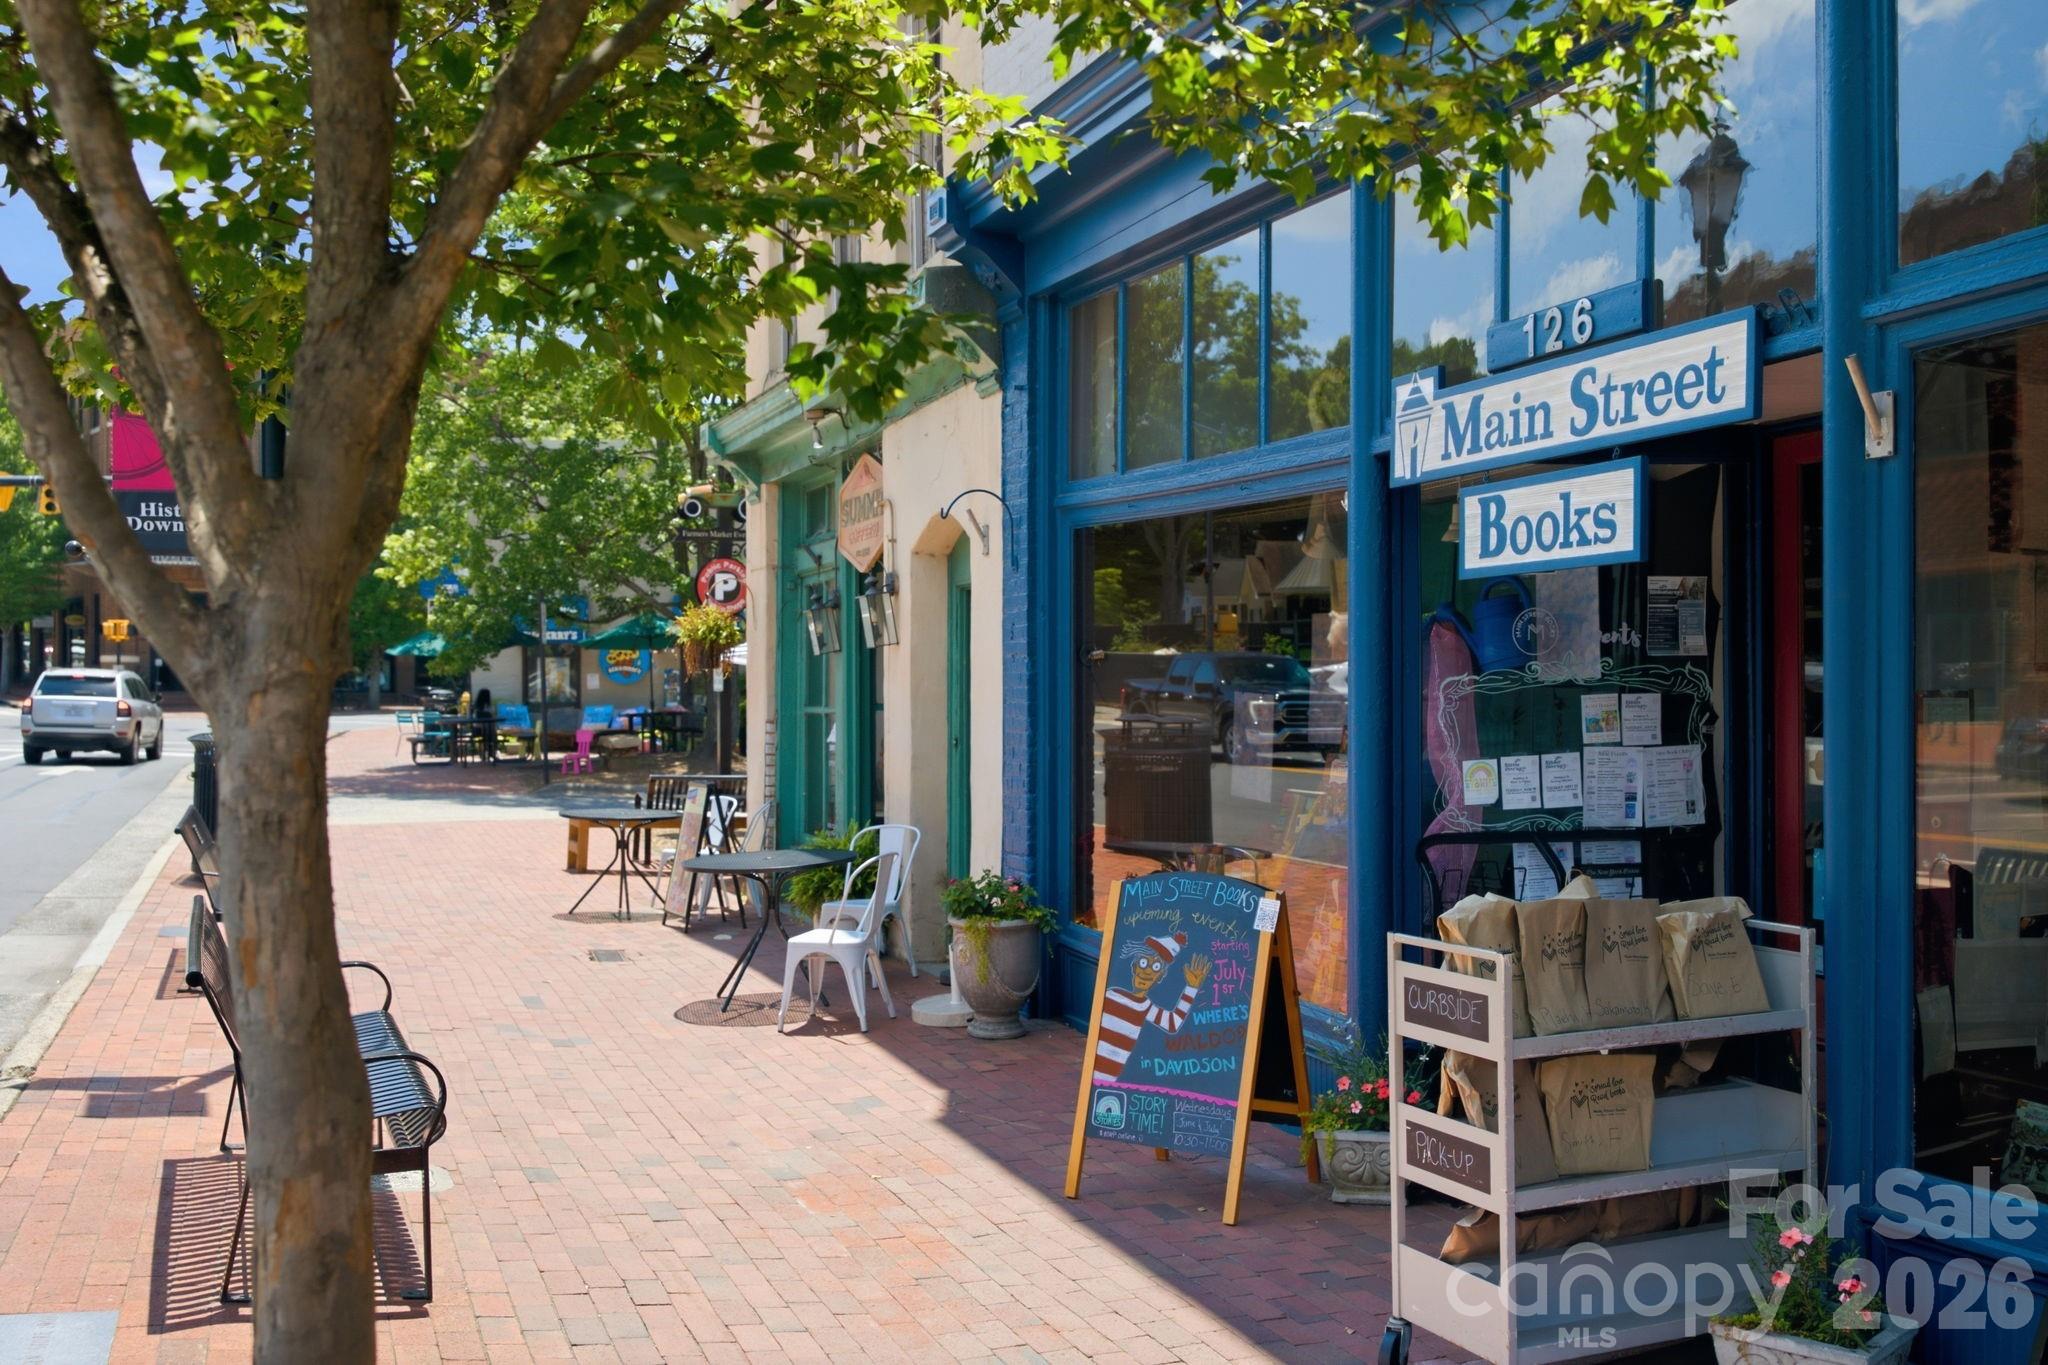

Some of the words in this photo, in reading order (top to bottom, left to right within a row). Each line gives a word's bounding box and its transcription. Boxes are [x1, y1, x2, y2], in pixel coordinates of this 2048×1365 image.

[1522, 297, 1594, 358] 126
[1441, 391, 1554, 461] Main
[1570, 345, 1726, 437] Street
[139, 502, 182, 517] Hist
[126, 516, 186, 532] Down
[709, 530, 733, 539] Market
[1477, 491, 1618, 559] Books
[1599, 621, 1642, 648] ents
[1123, 880, 1164, 907] MAIN
[1164, 877, 1214, 902] STREET
[1213, 881, 1258, 913] BOOKS
[1123, 908, 1184, 932] upcoming
[1210, 940, 1250, 959] starting
[1213, 958, 1247, 990] July
[1192, 1004, 1249, 1026] WHERE'S
[1407, 984, 1484, 1025] CURBSIDE
[1139, 1054, 1153, 1070] in
[1153, 1055, 1236, 1077] DAVIDSON
[1128, 1094, 1168, 1114] STORY
[1174, 1098, 1233, 1119] Wednesdays
[1128, 1111, 1165, 1135] TIME!
[1415, 1130, 1475, 1174] PICK-UP
